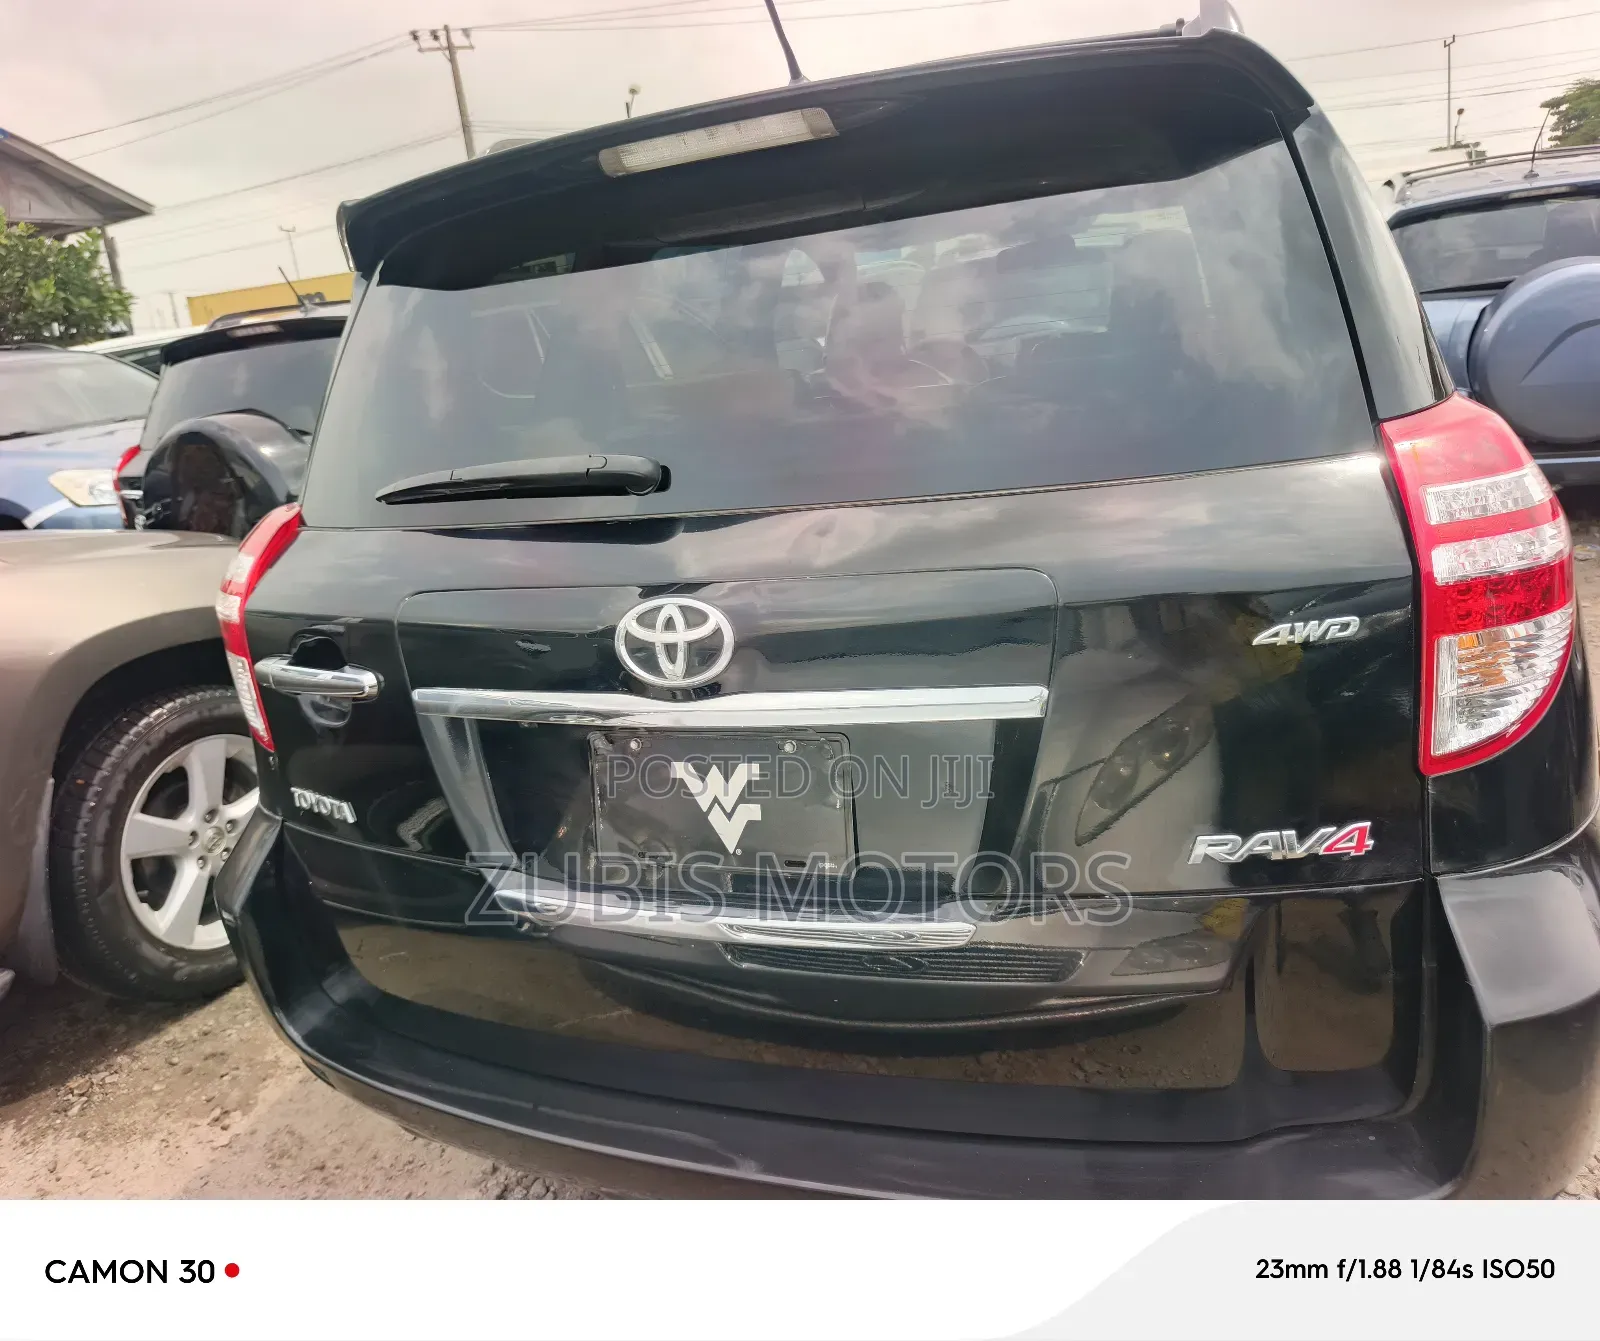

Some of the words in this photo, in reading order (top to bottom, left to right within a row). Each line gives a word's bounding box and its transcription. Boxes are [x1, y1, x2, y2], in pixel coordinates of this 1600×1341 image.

[1252, 616, 1360, 646] 4WD
[290, 787, 357, 824] TOYOTA
[1188, 821, 1374, 864] RAV4
